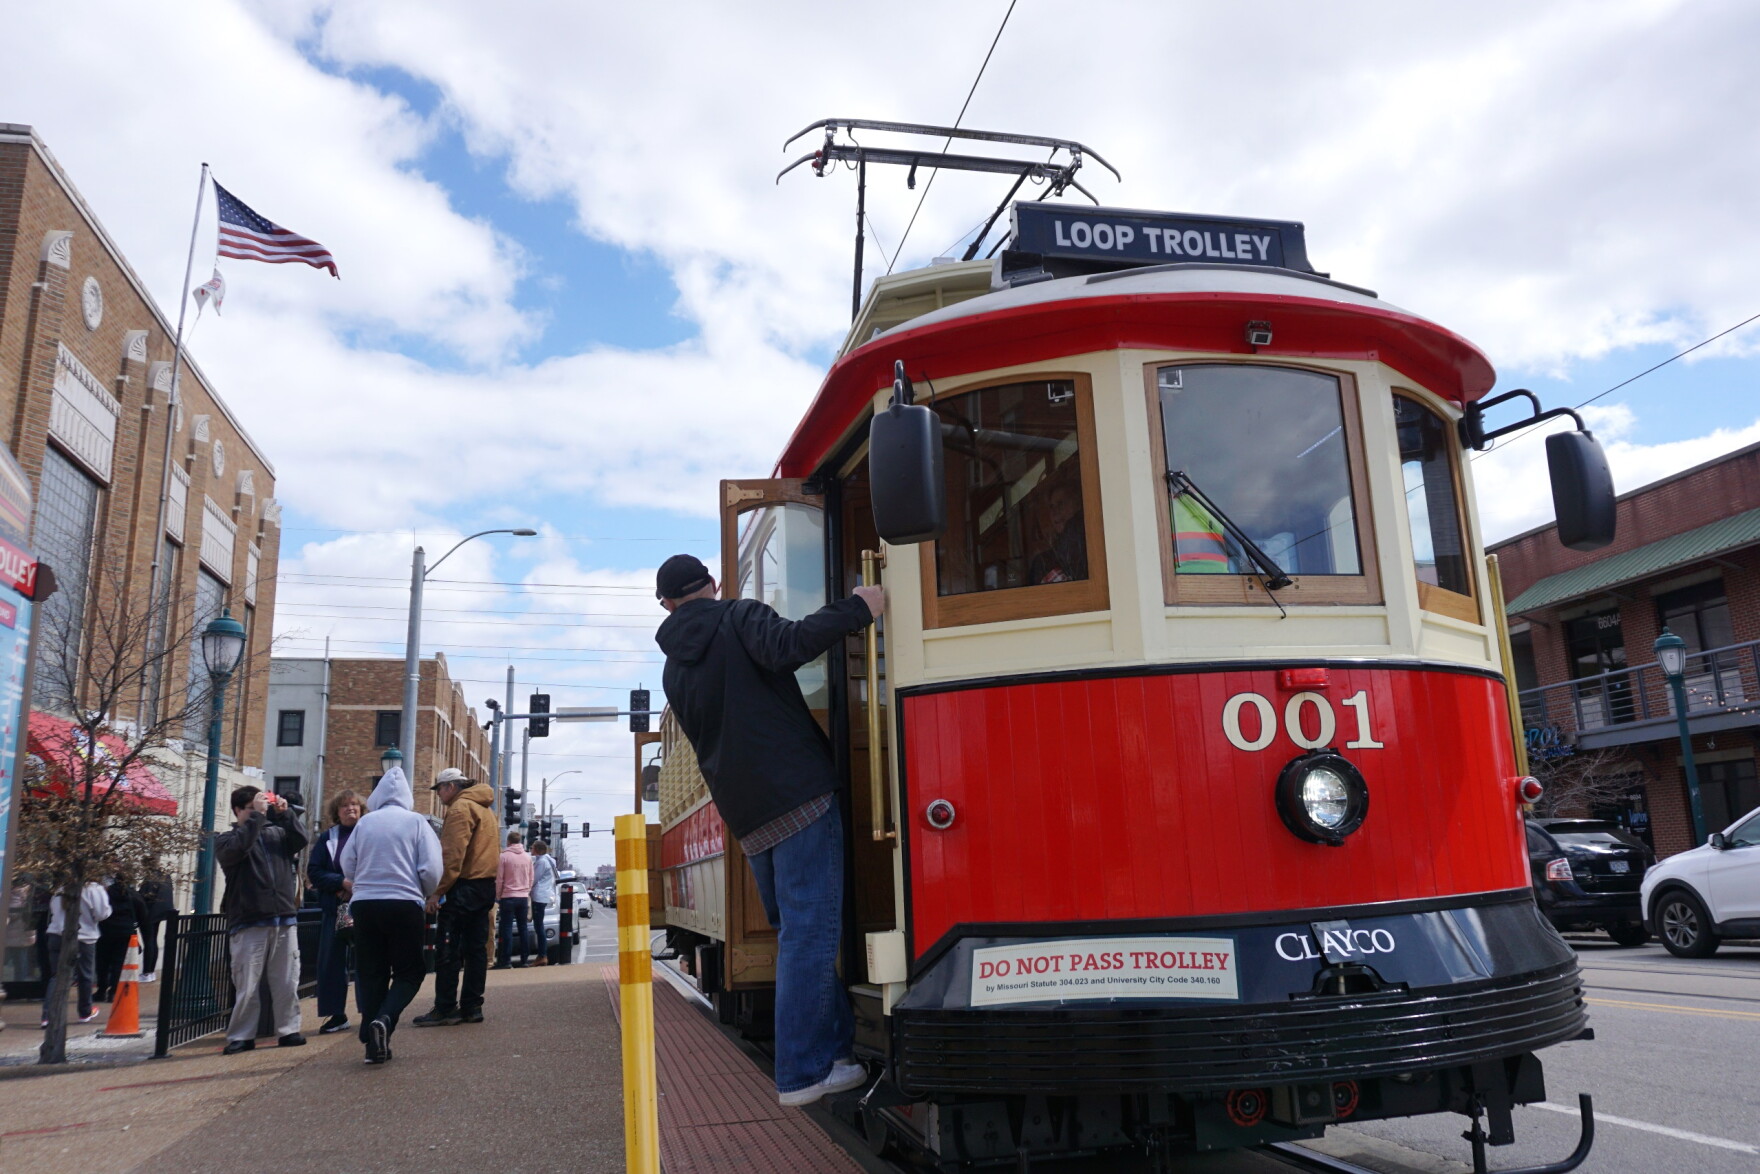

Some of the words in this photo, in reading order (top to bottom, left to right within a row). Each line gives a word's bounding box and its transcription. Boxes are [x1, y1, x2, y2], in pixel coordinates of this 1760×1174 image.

[1054, 220, 1135, 251] LOOP
[1143, 227, 1271, 261] TROLLEY
[1222, 690, 1384, 752] 001
[1274, 928, 1396, 962] CLAYCO
[979, 960, 1011, 980] DO
[1016, 955, 1064, 975] NOT
[1069, 952, 1125, 972] PASS
[1129, 951, 1230, 971] TROLLEY
[985, 984, 995, 993] by
[996, 982, 1029, 991] Missouri
[1030, 979, 1058, 988] Statute
[1059, 978, 1089, 987] 304.023
[1090, 977, 1105, 985] and
[1107, 976, 1148, 985] University
[1149, 975, 1165, 985] City
[1167, 975, 1189, 984] Code
[1190, 976, 1221, 985] 340.160
